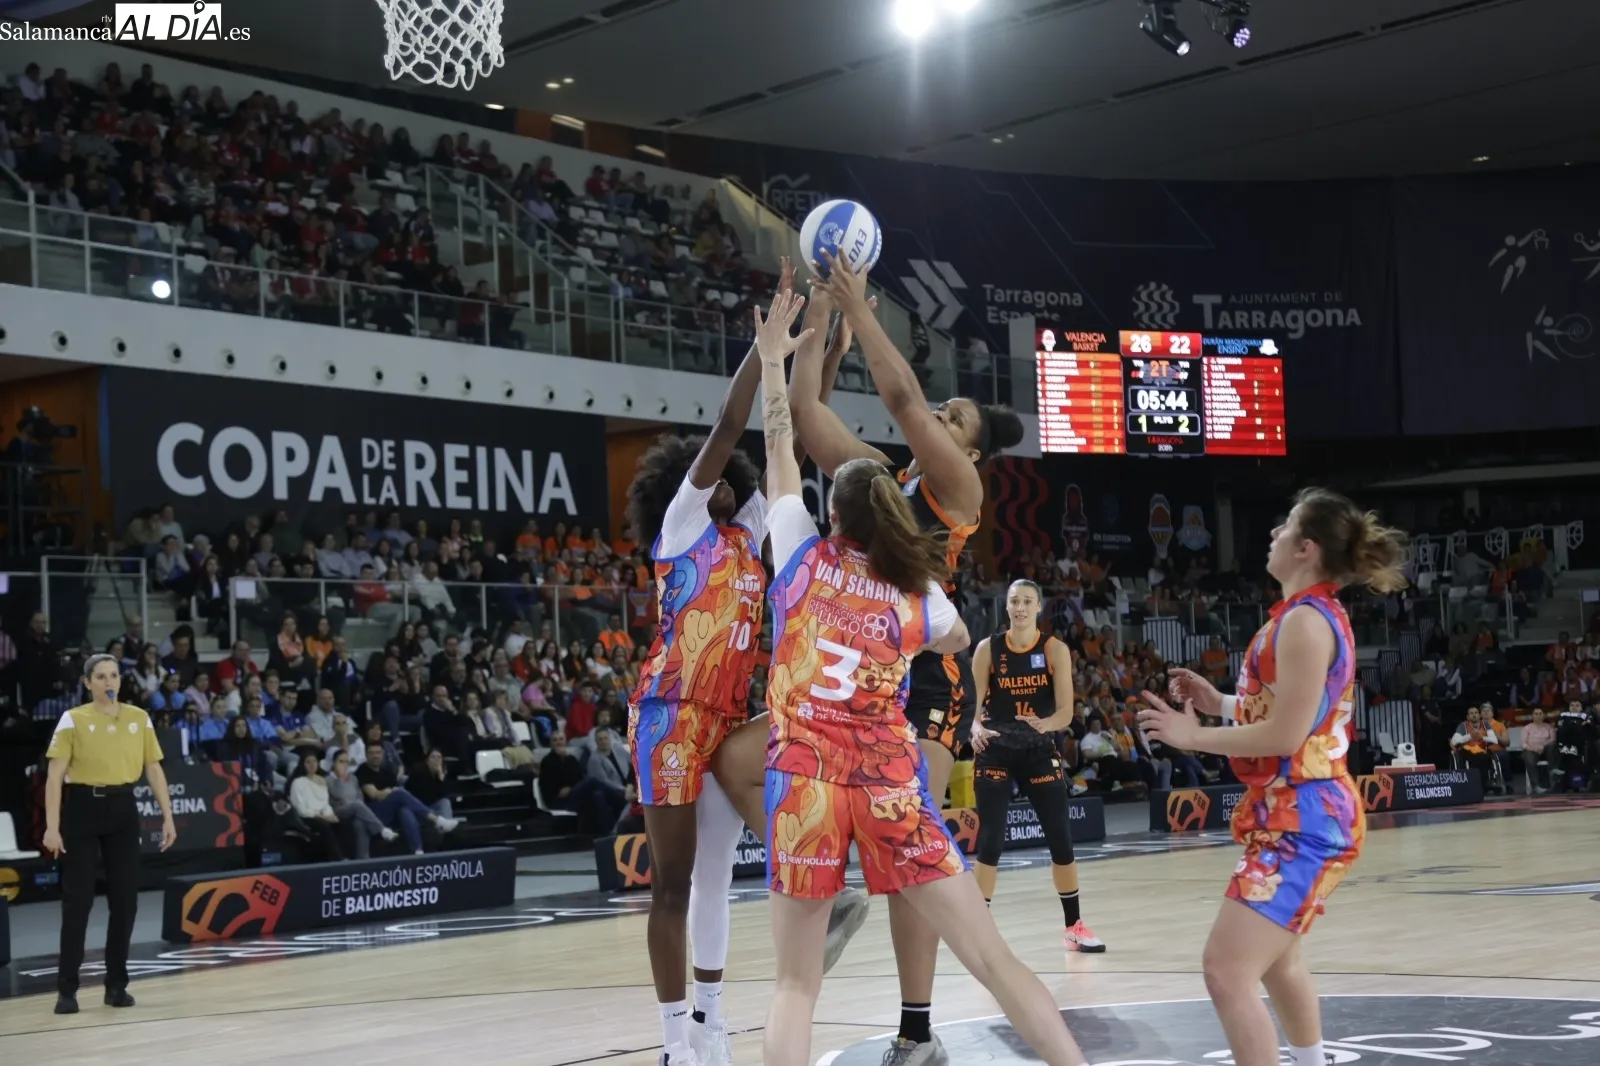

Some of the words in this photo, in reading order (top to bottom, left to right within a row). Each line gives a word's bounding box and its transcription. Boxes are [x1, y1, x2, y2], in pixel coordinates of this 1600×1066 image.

[981, 284, 1083, 309] Tarragona
[1229, 292, 1317, 304] AJUNTAMENT
[1323, 291, 1343, 302] DE
[1064, 331, 1107, 344] VALENCIA
[1130, 333, 1152, 353] 26
[1169, 335, 1191, 354] 22
[1217, 345, 1249, 355] ENSINO
[1150, 360, 1170, 378] 2T
[1137, 389, 1189, 411] 05:44
[1138, 414, 1147, 433] 1
[1178, 414, 1190, 433] 2
[157, 422, 357, 503] COPA
[361, 437, 396, 471] DE
[403, 439, 579, 516] REINA
[362, 473, 399, 506] LA
[815, 559, 845, 590] VAN
[818, 609, 861, 634] LUGO
[727, 620, 751, 651] 10
[809, 637, 862, 701] 3
[998, 674, 1049, 689] VALENCIA
[1010, 687, 1037, 696] BASKET
[1014, 701, 1035, 717] 14
[1404, 772, 1440, 787] FEDERACIÓN
[1440, 770, 1469, 784] ESPAÑOLA
[874, 791, 899, 803] Concello
[1406, 788, 1415, 800] DE
[1415, 786, 1452, 799] BALONCESTO
[960, 811, 976, 830] FEB
[1222, 808, 1231, 821] DE
[901, 840, 944, 861] galicia
[788, 855, 802, 865] NEW
[803, 856, 841, 867] HOLLAND
[322, 864, 413, 896] FEDERACIÓN
[415, 859, 485, 885] ESPAÑOLA
[251, 879, 280, 906] FEB
[321, 898, 341, 919] DE
[345, 886, 439, 915] BALONCESTO
